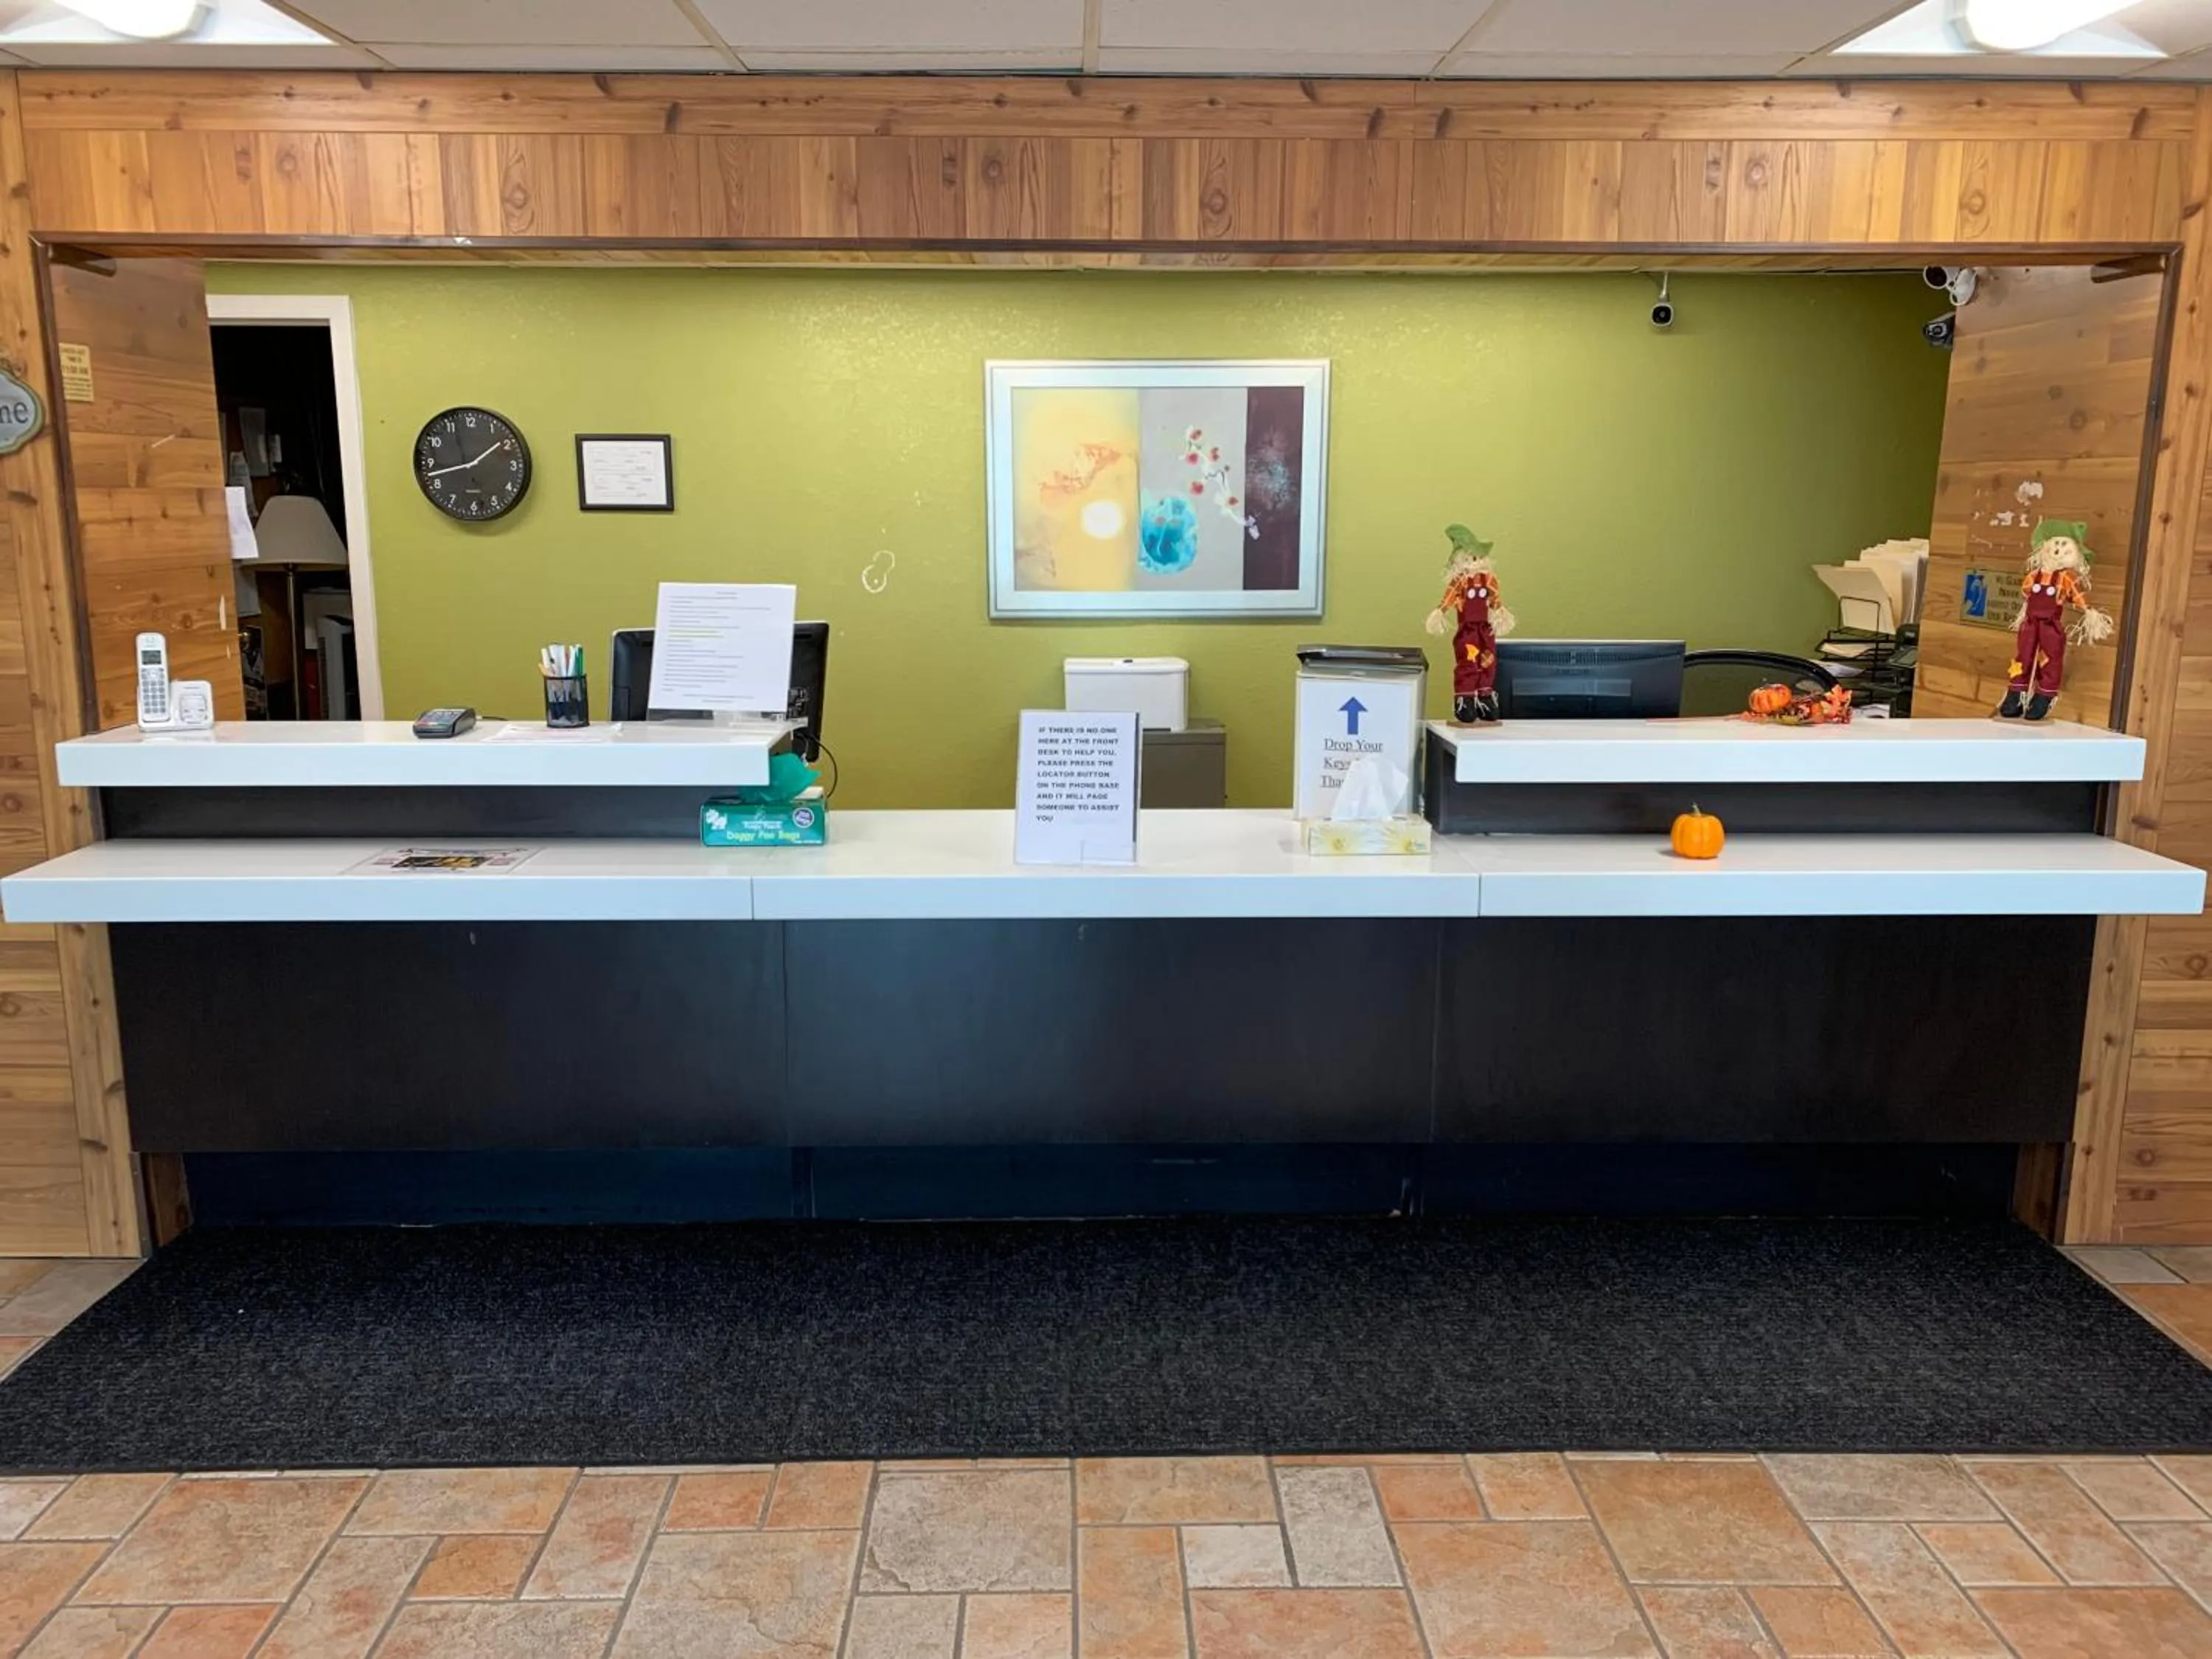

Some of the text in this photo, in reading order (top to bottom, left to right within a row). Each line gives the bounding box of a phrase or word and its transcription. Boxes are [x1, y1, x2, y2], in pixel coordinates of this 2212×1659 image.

[446, 422, 455, 433] 11
[466, 417, 476, 428] 12
[490, 423, 494, 434] 1
[431, 437, 442, 448] 10
[504, 439, 511, 451] 2
[428, 458, 434, 468] 9
[510, 460, 517, 471] 3
[434, 479, 442, 490] 8
[505, 481, 512, 492] 4
[450, 494, 456, 504] 7
[491, 495, 498, 507] 5
[470, 501, 478, 512] 6
[1324, 738, 1383, 753] Drop Your
